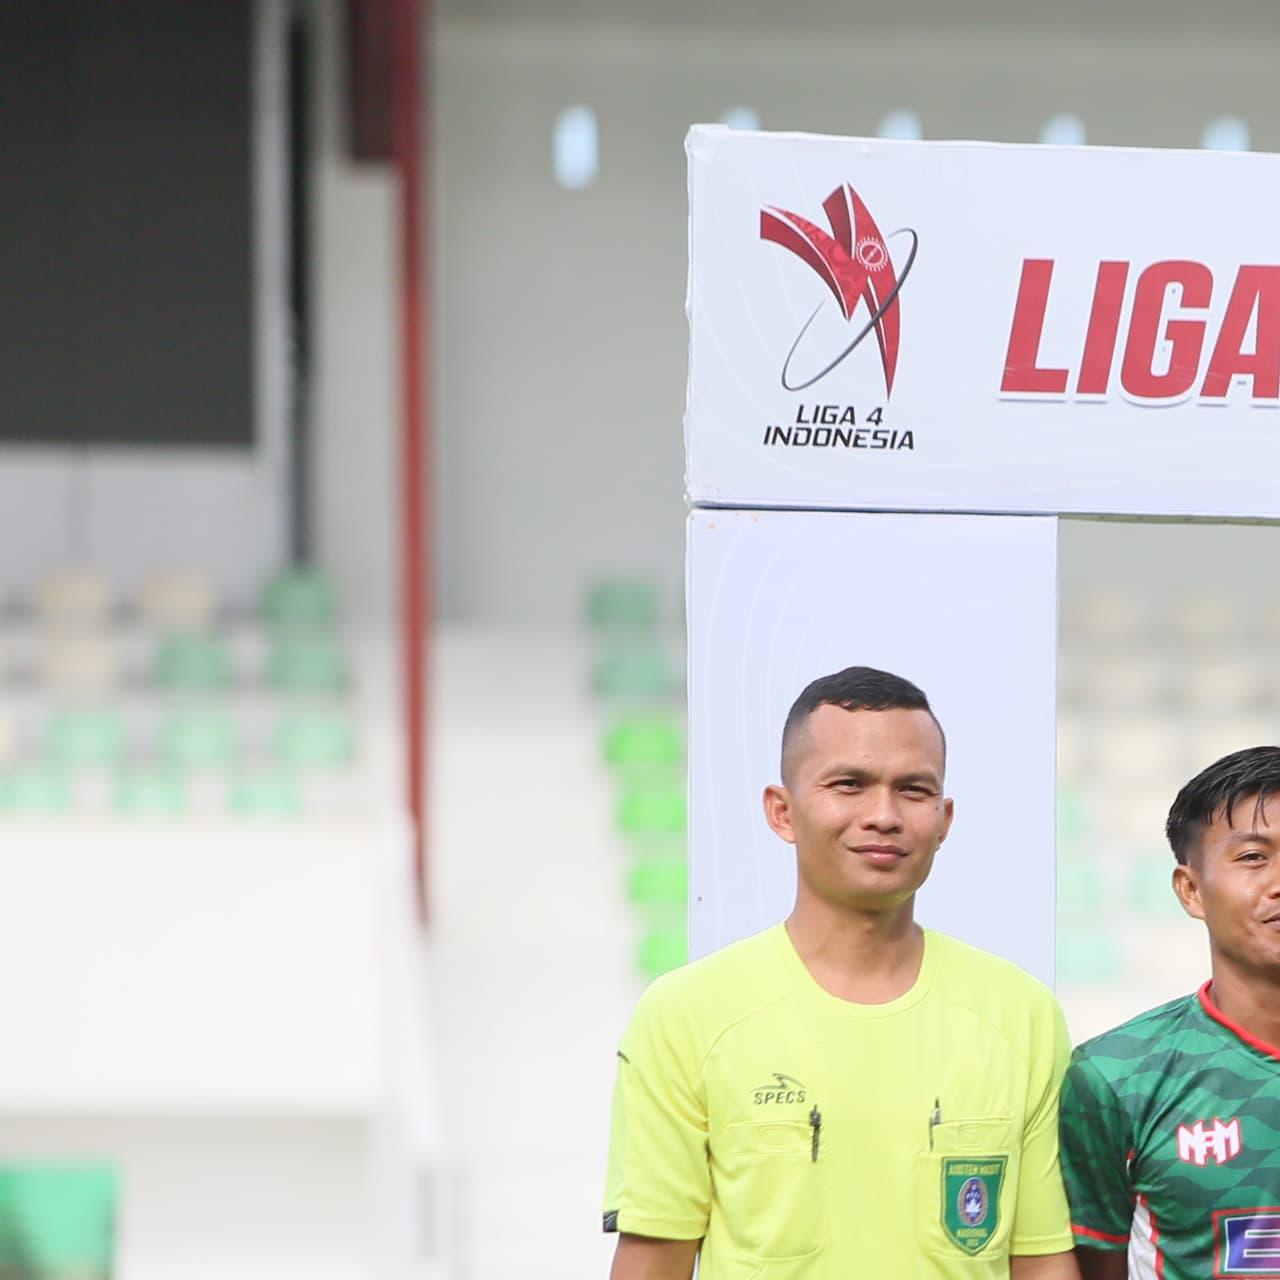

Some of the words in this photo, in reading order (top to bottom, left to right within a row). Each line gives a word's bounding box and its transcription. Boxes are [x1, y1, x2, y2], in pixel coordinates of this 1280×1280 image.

[796, 404, 856, 425] LIGA
[866, 406, 883, 426] 4
[763, 425, 915, 451] INDONESIA
[753, 1090, 806, 1105] SPECS
